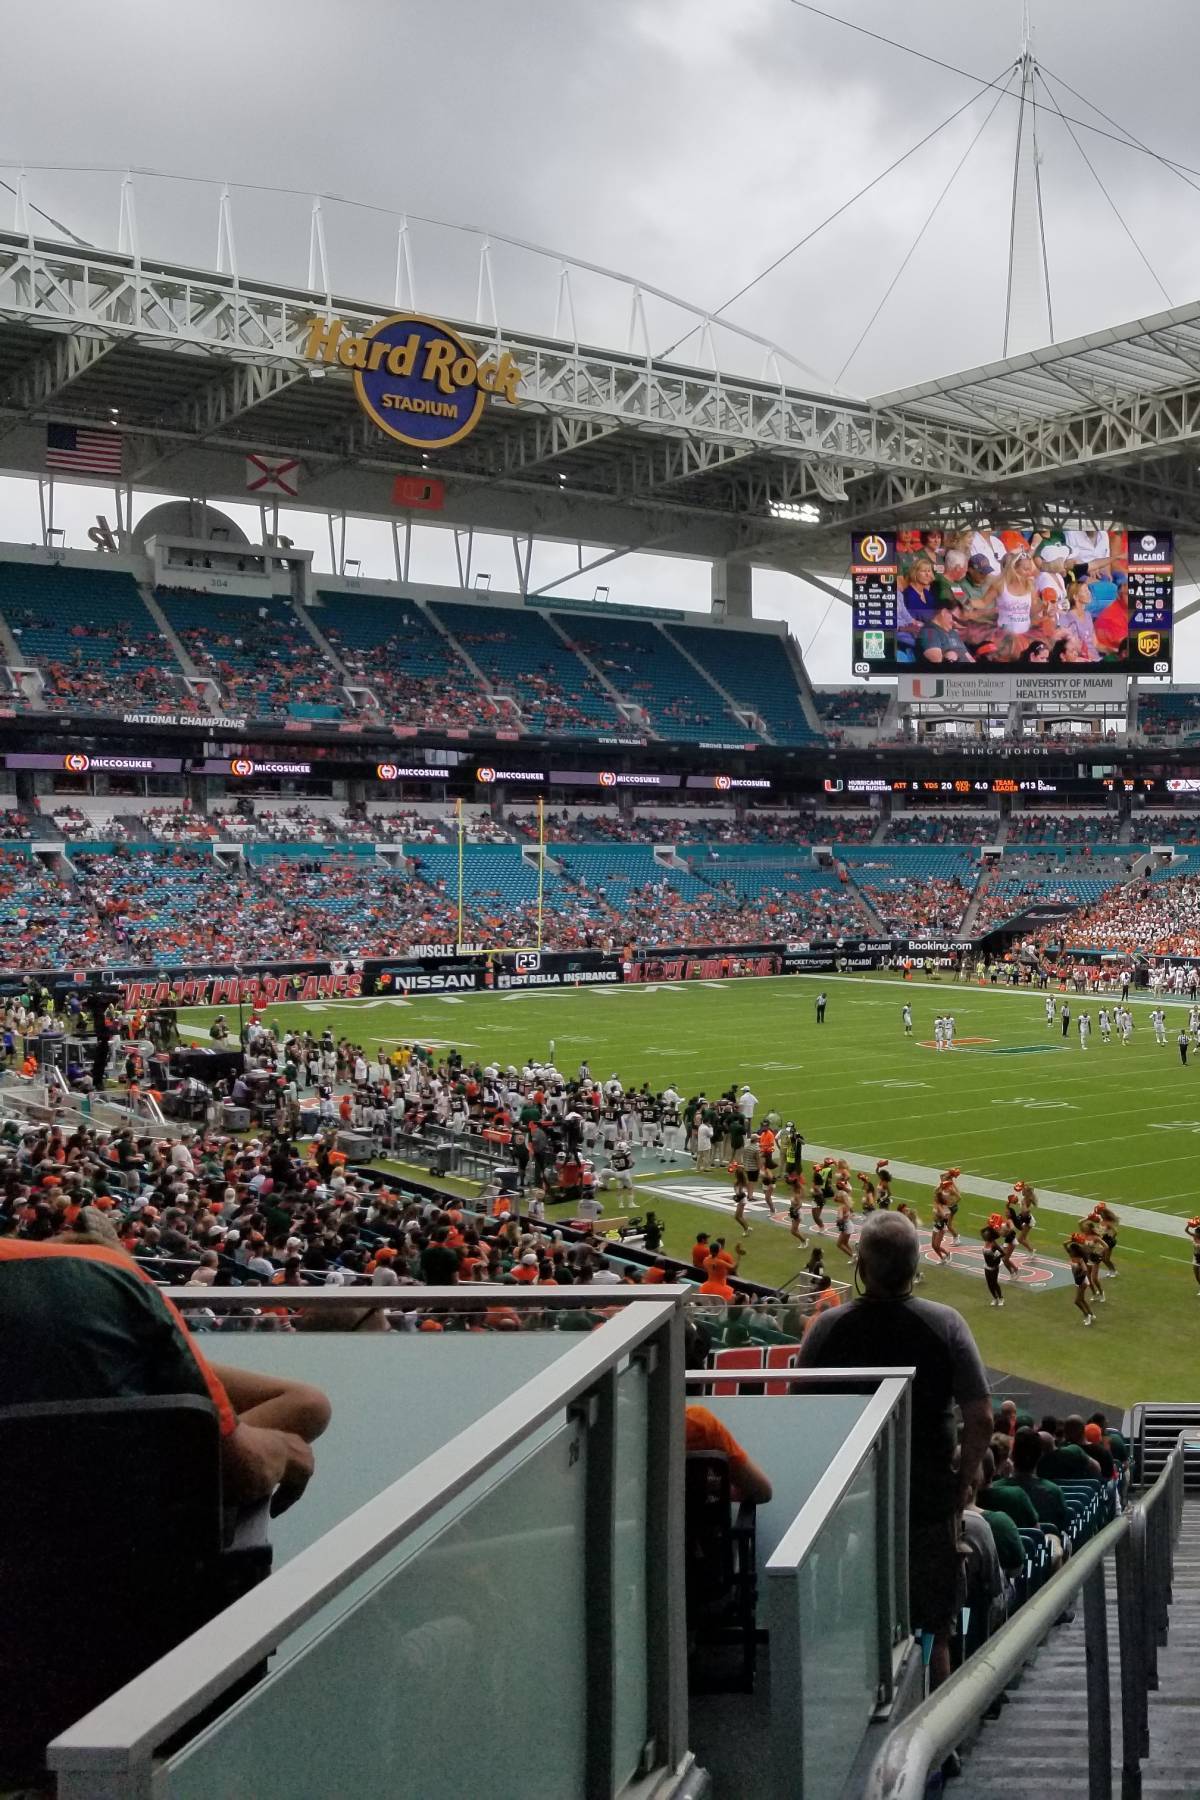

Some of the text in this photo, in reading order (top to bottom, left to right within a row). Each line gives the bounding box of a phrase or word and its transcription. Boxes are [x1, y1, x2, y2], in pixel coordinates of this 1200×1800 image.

[304, 318, 522, 404] Hard Rock
[382, 394, 458, 419] STADIUM
[1134, 552, 1165, 561] BACARDÍ
[1140, 639, 1159, 652] ups
[857, 664, 868, 672] CC
[978, 679, 1005, 688] Palmer
[1016, 679, 1113, 688] UNIVERSITY OF MIAMI
[962, 689, 992, 697] Institute
[1016, 690, 1087, 699] HEALTH SYSTEM
[123, 714, 245, 729] NATIONAL CHAMPIONS
[90, 758, 153, 768] MICCOSUKEE
[254, 763, 311, 773] MICCOSUKEE
[398, 768, 449, 777] MICCOSUKEE
[496, 771, 544, 781] MICCOSUKEE
[617, 775, 660, 784] MICCOSUKEE
[731, 779, 771, 787] MICCOSUKEE
[409, 944, 484, 958] MUSCLE MILK
[908, 941, 971, 951] Booking.com
[519, 954, 537, 967] 25
[848, 957, 872, 965] BACARDÍ
[395, 974, 476, 989] NISSAN
[564, 971, 617, 982] INSURANCE
[212, 974, 364, 1005] HURRIANES
